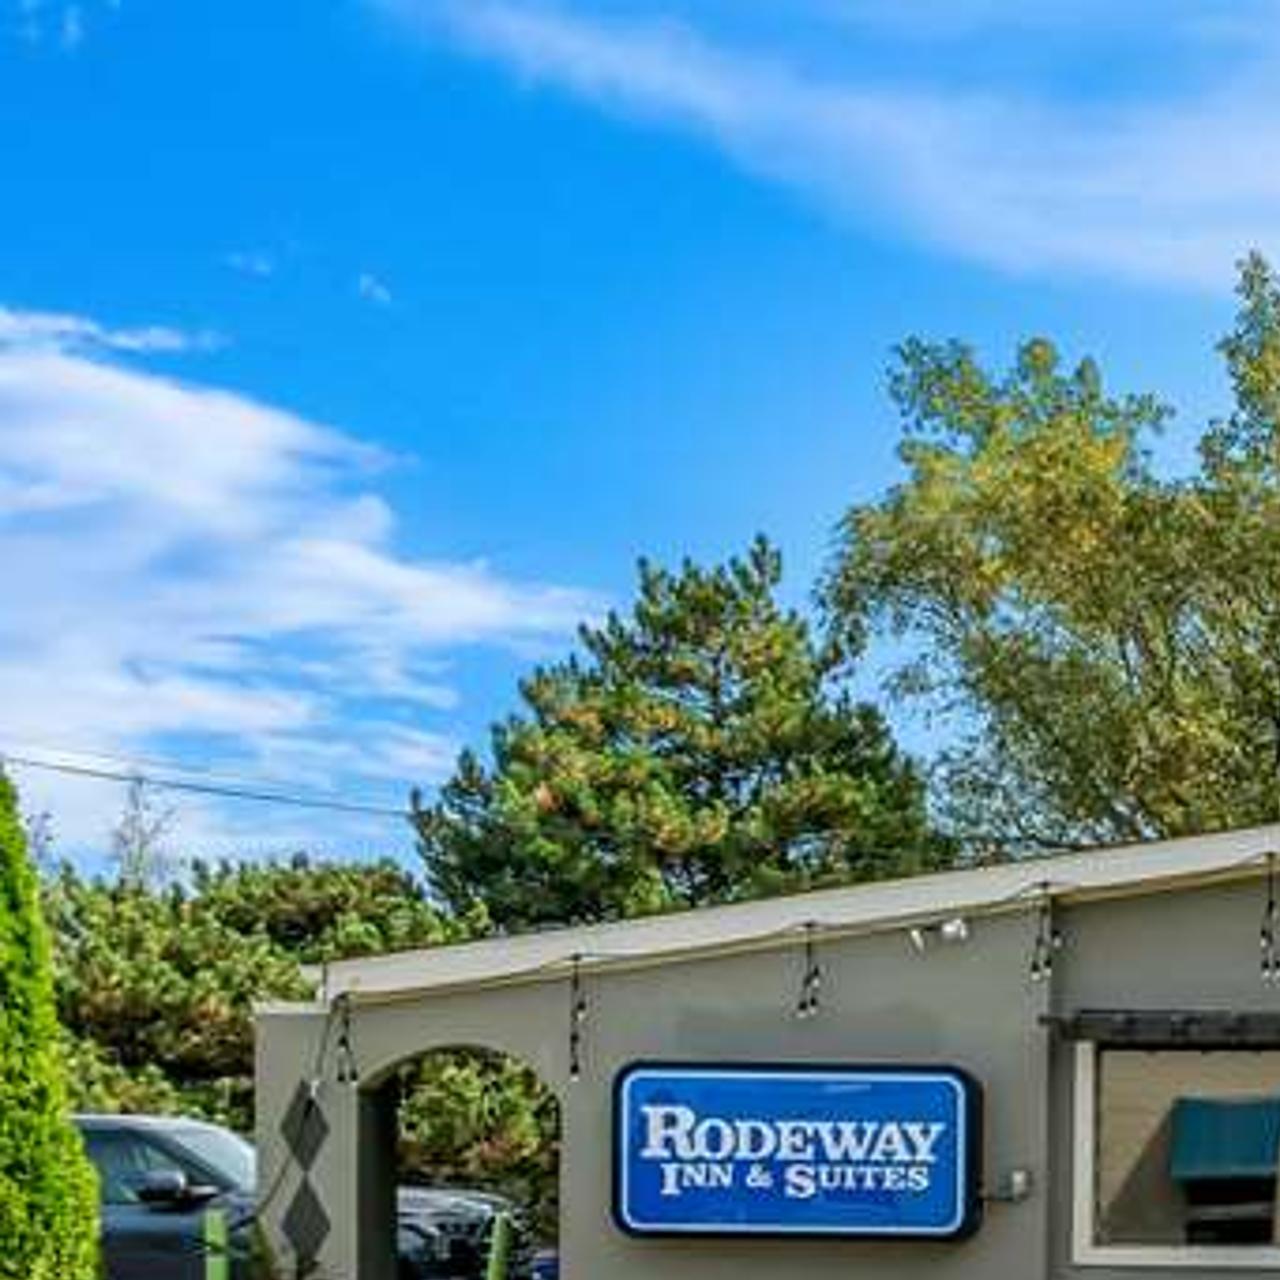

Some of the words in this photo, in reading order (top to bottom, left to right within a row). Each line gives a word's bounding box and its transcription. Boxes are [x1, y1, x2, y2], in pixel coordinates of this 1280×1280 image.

[640, 1105, 946, 1161] RODEWAY
[660, 1163, 733, 1195] INN
[745, 1164, 773, 1188] &
[784, 1163, 929, 1198] SUITES
